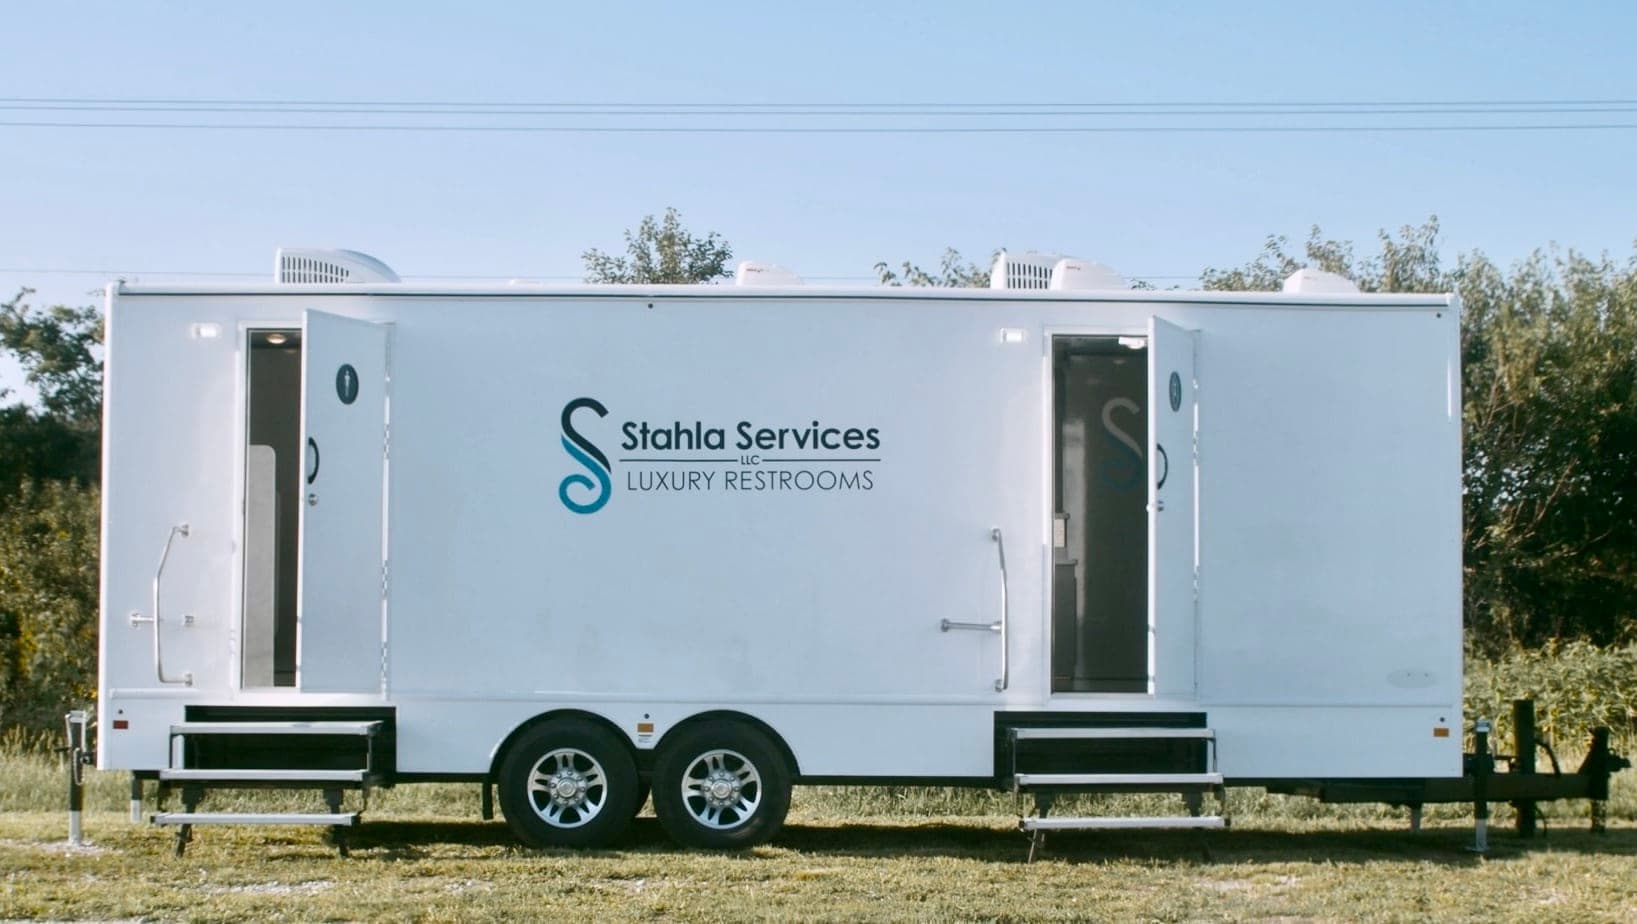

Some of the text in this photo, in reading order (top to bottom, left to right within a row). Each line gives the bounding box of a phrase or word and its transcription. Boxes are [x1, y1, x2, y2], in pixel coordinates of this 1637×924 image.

[621, 420, 881, 451] Stahla Services
[740, 455, 760, 466] LLC
[627, 469, 875, 492] LUXURY RESTROOMS
